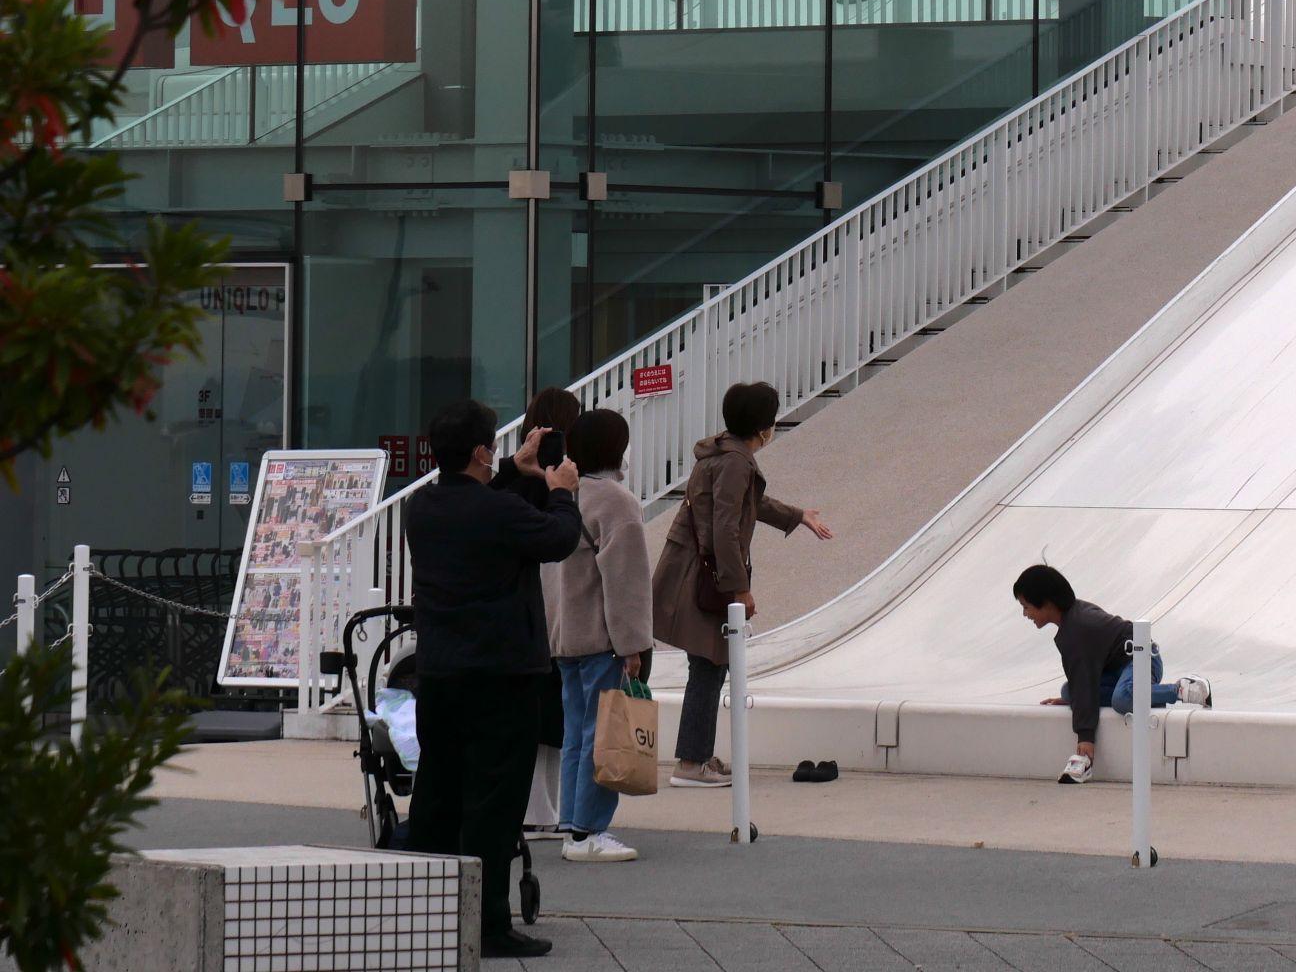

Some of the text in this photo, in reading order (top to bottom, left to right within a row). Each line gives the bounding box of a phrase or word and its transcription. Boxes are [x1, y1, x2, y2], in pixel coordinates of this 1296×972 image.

[200, 286, 269, 315] UNIQLO
[198, 390, 211, 402] 3F
[635, 728, 655, 749] GU
